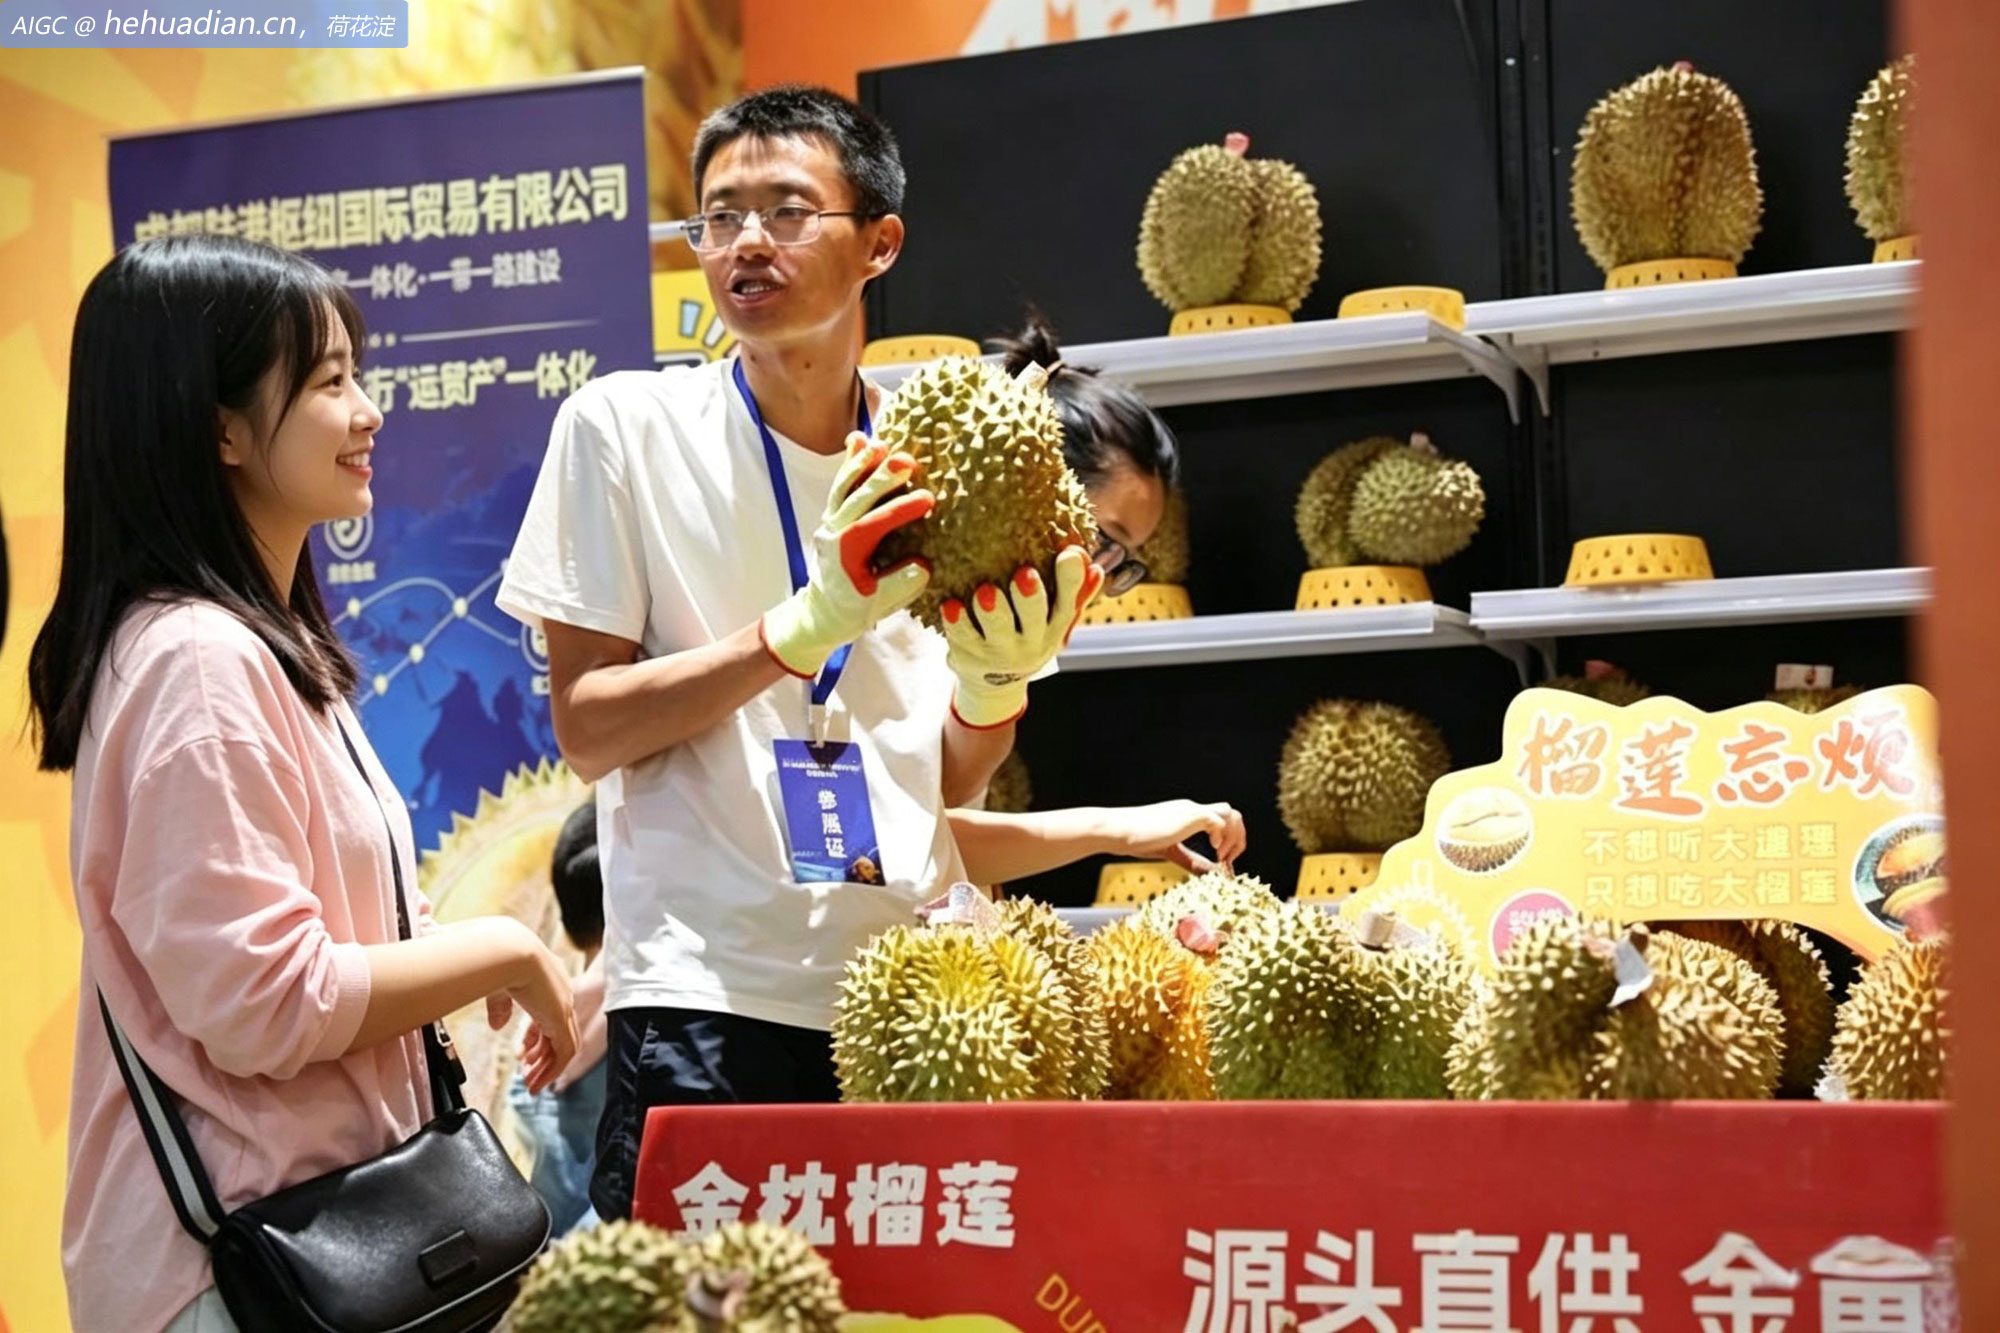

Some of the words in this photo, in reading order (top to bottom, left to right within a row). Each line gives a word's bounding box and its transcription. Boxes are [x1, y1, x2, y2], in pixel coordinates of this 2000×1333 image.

[1517, 710, 1917, 816] 榴莲忘烦
[1584, 869, 1836, 907] 只想吃大榴莲
[672, 1161, 1019, 1248] 金枕榴莲
